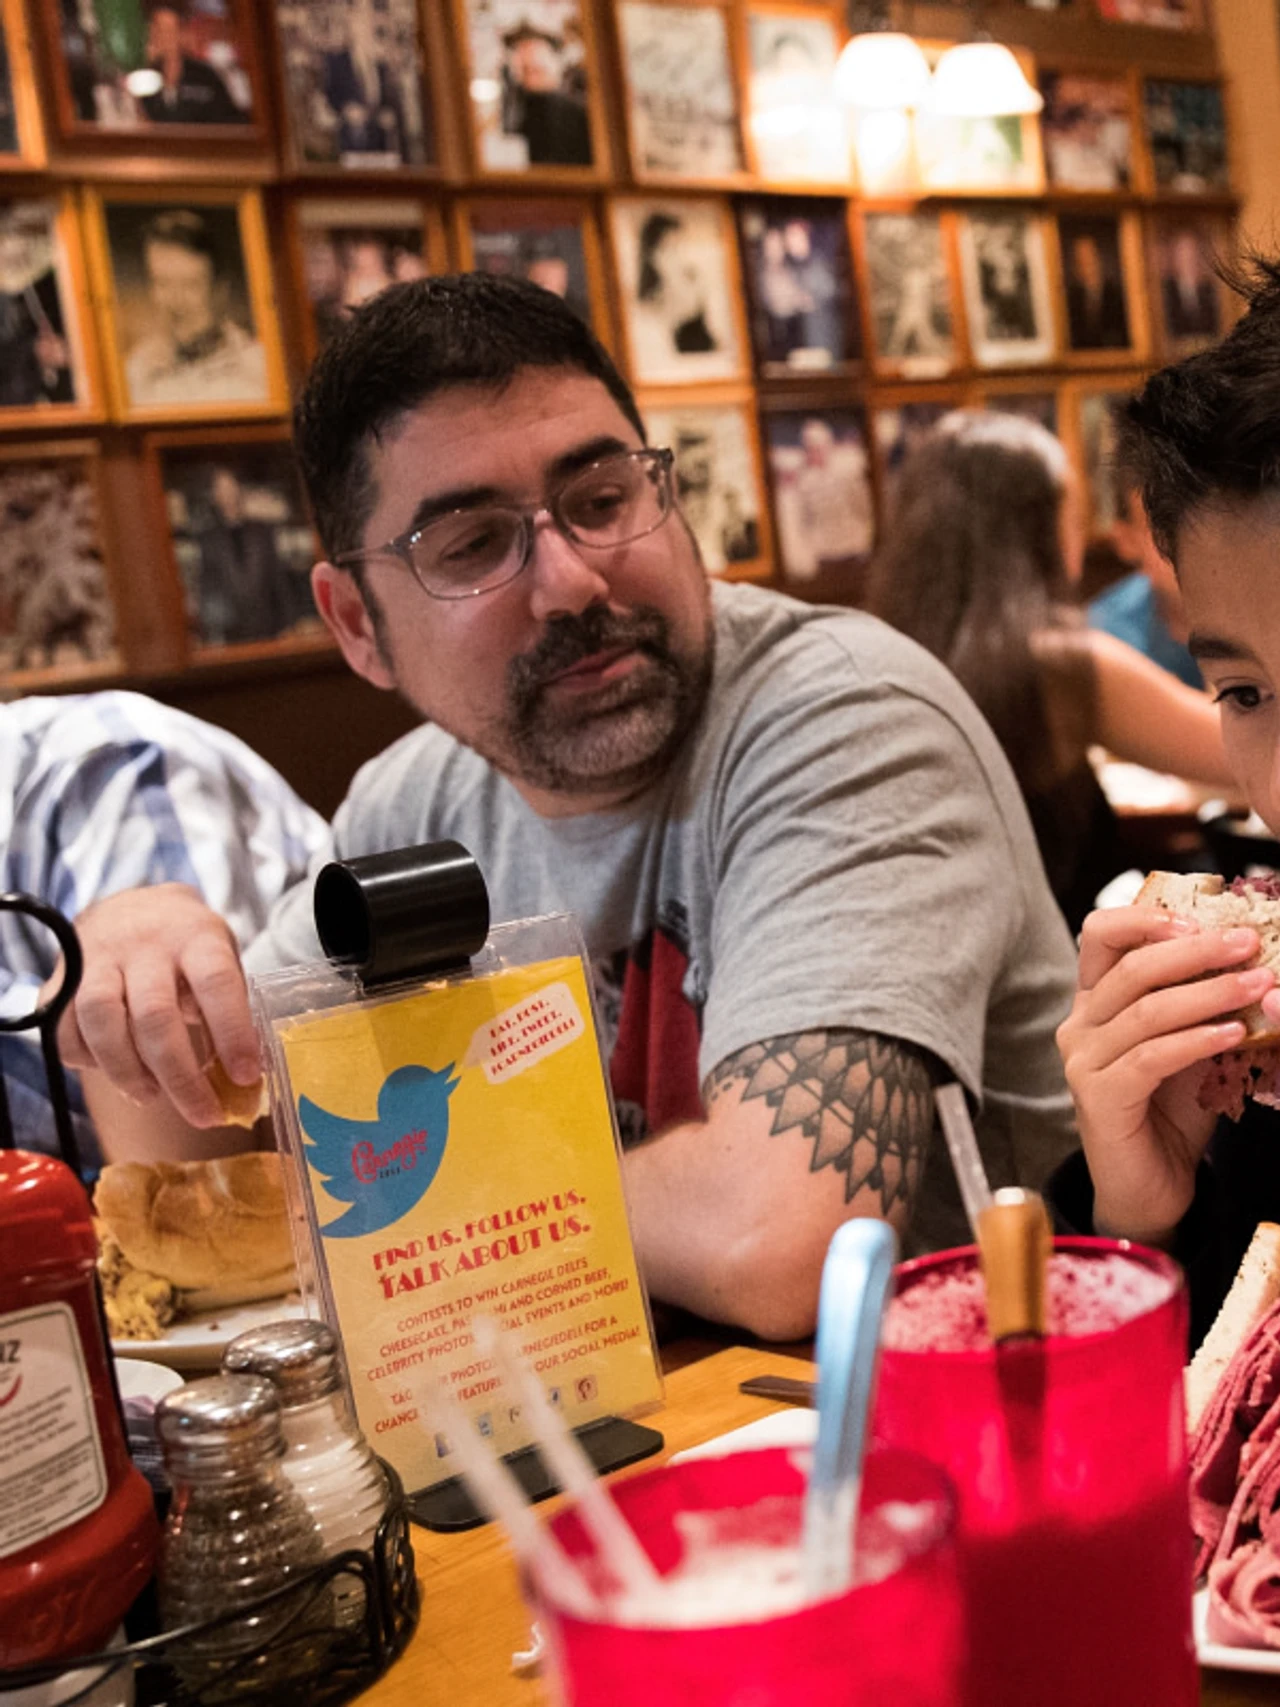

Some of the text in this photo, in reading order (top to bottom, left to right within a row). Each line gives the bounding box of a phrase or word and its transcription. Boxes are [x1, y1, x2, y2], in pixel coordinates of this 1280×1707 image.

[373, 1188, 587, 1270] FIND US. FOLLOW US.
[377, 1215, 591, 1300] TALK ABOUT US.
[397, 1302, 454, 1332] CONTESTS
[456, 1297, 473, 1311] TO
[475, 1287, 498, 1303] WIN
[502, 1268, 554, 1294] CARNEGIE
[510, 1294, 533, 1311] AND
[536, 1277, 581, 1301] CORNED
[584, 1317, 608, 1333] FOR
[610, 1315, 618, 1327] A
[367, 1350, 424, 1381] CELEBRITY
[525, 1301, 566, 1323] EVENTS
[569, 1292, 592, 1309] AND
[594, 1278, 629, 1300] MORE!
[535, 1355, 560, 1373] OUR
[562, 1341, 601, 1364] SOCIAL
[602, 1325, 640, 1348] MEDIA!
